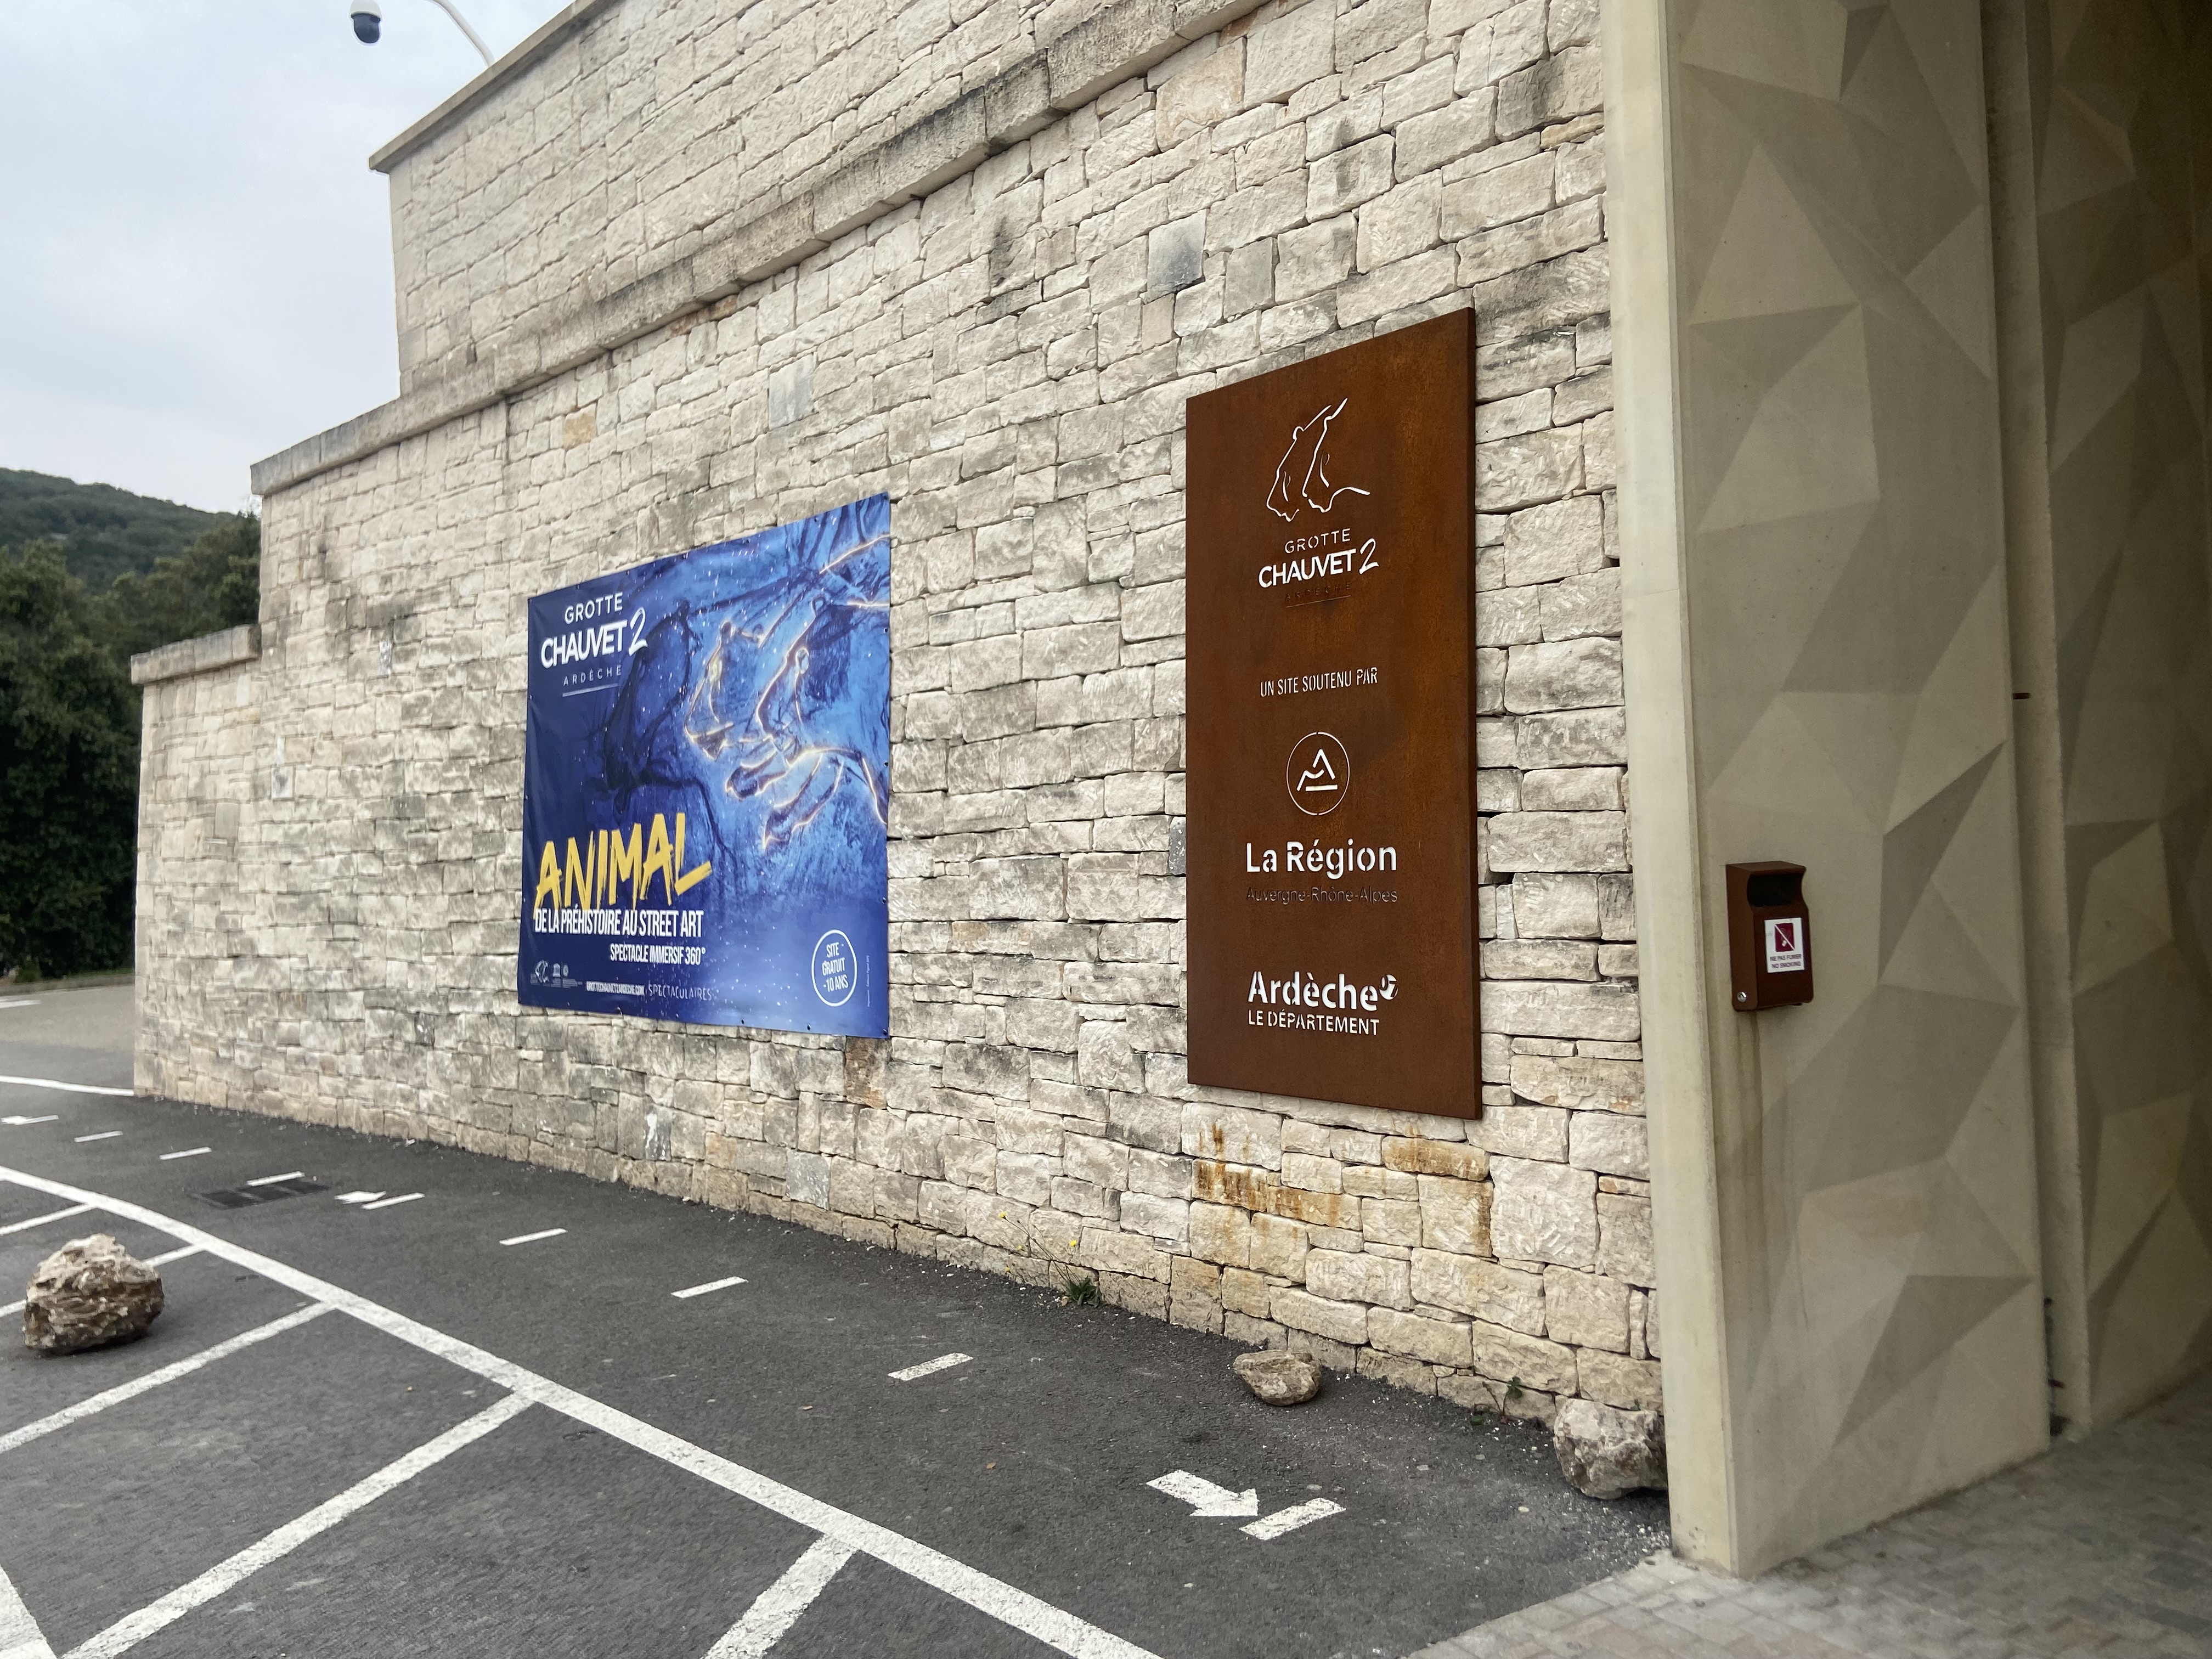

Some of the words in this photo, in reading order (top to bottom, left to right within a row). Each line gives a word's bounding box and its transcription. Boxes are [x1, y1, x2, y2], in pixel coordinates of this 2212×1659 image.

[1285, 528, 1351, 554] GROTTE
[1259, 548, 1356, 588] CHAUVET
[1359, 538, 1379, 574] 2
[565, 591, 623, 624] GROTTE
[541, 619, 628, 668] CHAUVET
[628, 607, 648, 657] 2
[1261, 680, 1274, 697] UN
[1277, 677, 1299, 695] SITE
[1302, 670, 1352, 692] SOUTENU
[1357, 667, 1378, 685] PAR
[533, 812, 713, 919] ANIMAL
[1246, 842, 1277, 872] La
[1286, 838, 1397, 879] Région
[1246, 887, 1397, 905] Auvergne-Rhône-Alpes
[535, 908, 547, 933] DE
[549, 909, 559, 933] LA
[561, 904, 620, 935] PRÉHISTOIRE
[622, 909, 636, 936] AU
[639, 909, 679, 938] STREET
[680, 910, 704, 938] ART
[610, 943, 648, 963] SPECTACLE
[650, 945, 684, 964] IMMERSIF
[826, 942, 839, 958] SITE
[822, 957, 845, 976] GRATUIT
[835, 974, 849, 989] ANS
[1247, 970, 1378, 1011] Ardèche
[1248, 1009, 1263, 1026] LE
[1268, 1008, 1380, 1036] DÉPARTEMENT
